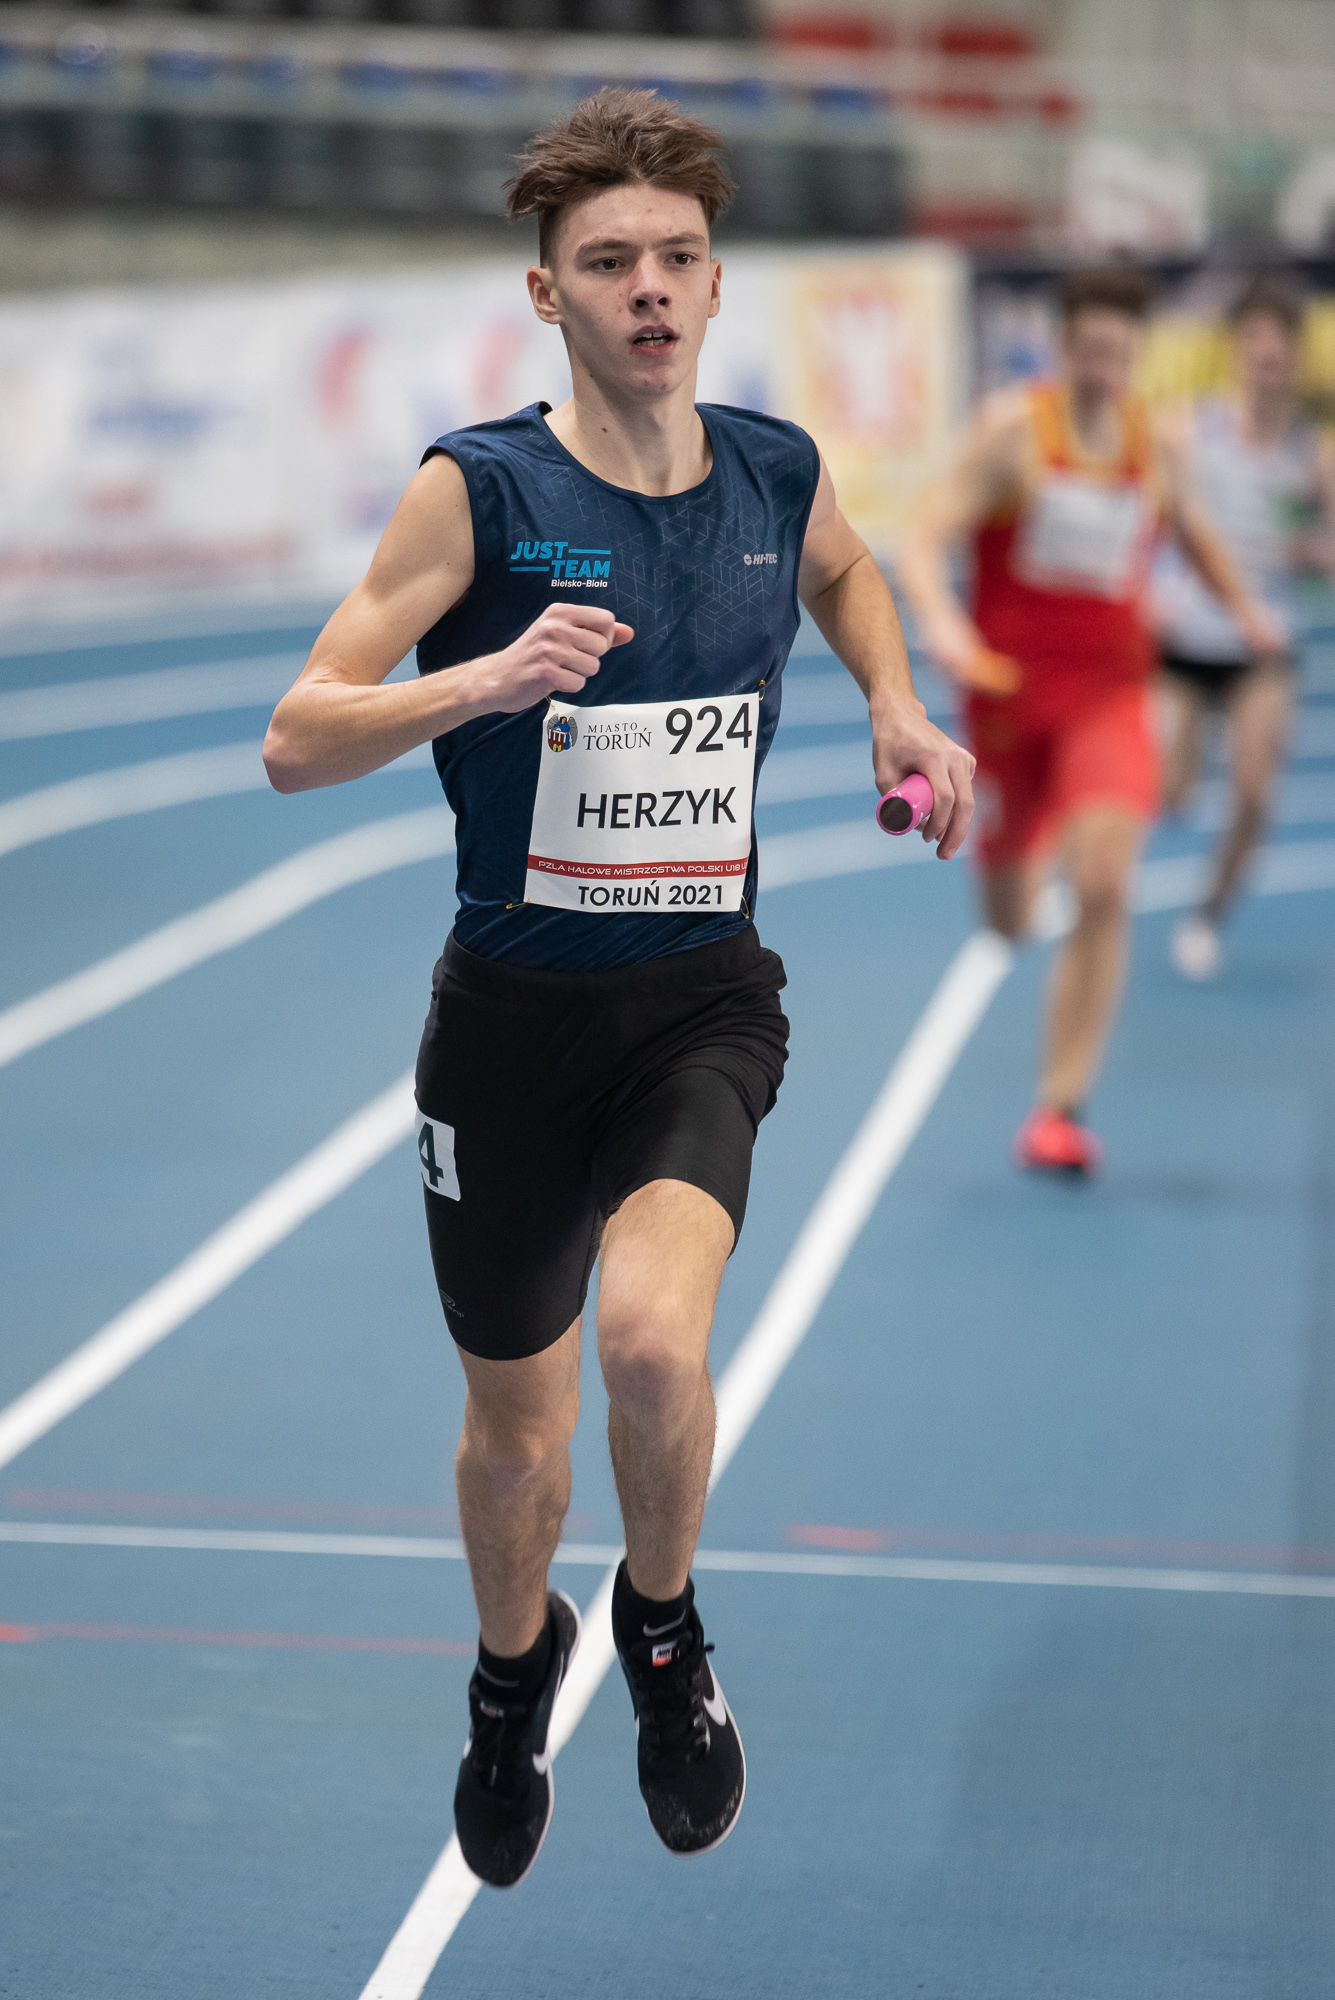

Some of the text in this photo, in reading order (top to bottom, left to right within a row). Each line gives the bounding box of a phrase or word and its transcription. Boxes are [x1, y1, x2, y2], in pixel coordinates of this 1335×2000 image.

[510, 541, 569, 560] JUST
[551, 560, 611, 578] TEAM
[583, 727, 652, 751] TORUŃ
[587, 722, 639, 733] MIASTO
[665, 702, 753, 755] 924
[576, 786, 737, 829] HERZYK
[538, 860, 566, 872] PZLA
[567, 865, 612, 876] HALOWE
[613, 866, 686, 876] MISTRZOSTWA
[687, 865, 723, 873] POLSKI
[725, 863, 741, 872] U18
[578, 879, 723, 907] TORUŃ 2021
[417, 1121, 445, 1189] 4
